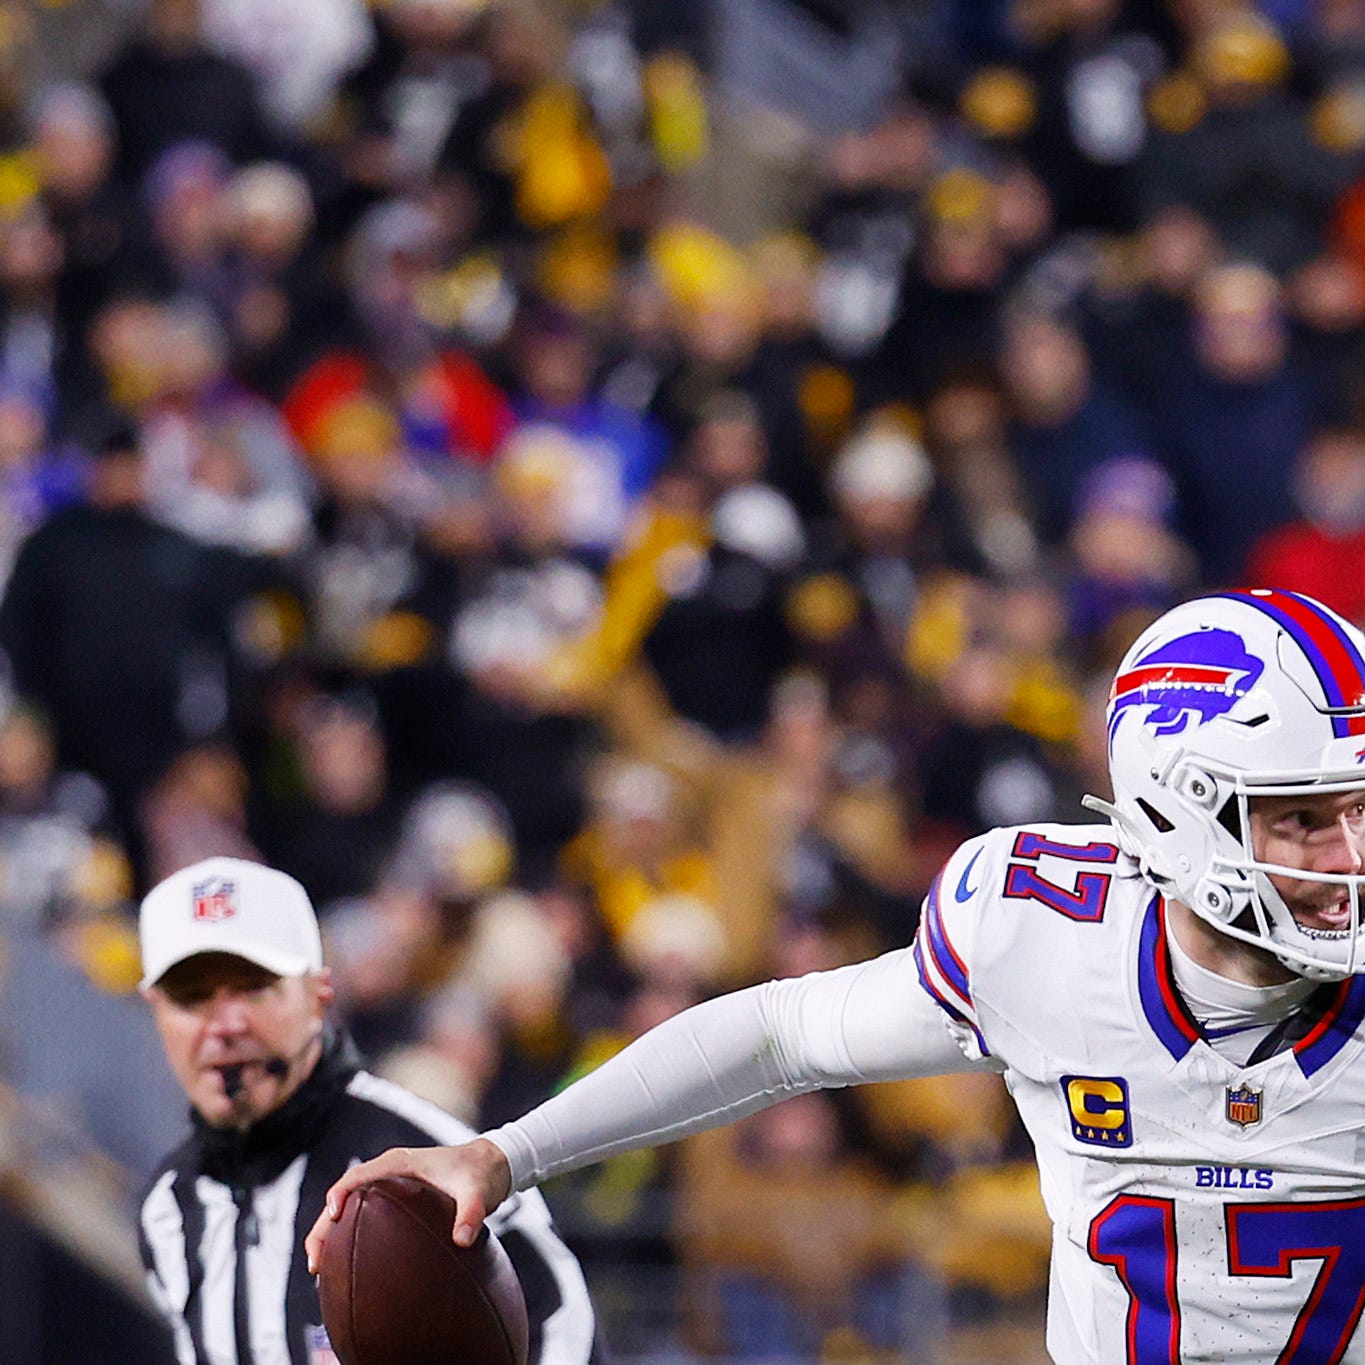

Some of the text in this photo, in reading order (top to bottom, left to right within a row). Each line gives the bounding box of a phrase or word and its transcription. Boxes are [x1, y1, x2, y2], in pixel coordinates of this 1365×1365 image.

[1002, 831, 1120, 923] 17
[1068, 1079, 1124, 1129] C
[1195, 1166, 1274, 1190] BILLS
